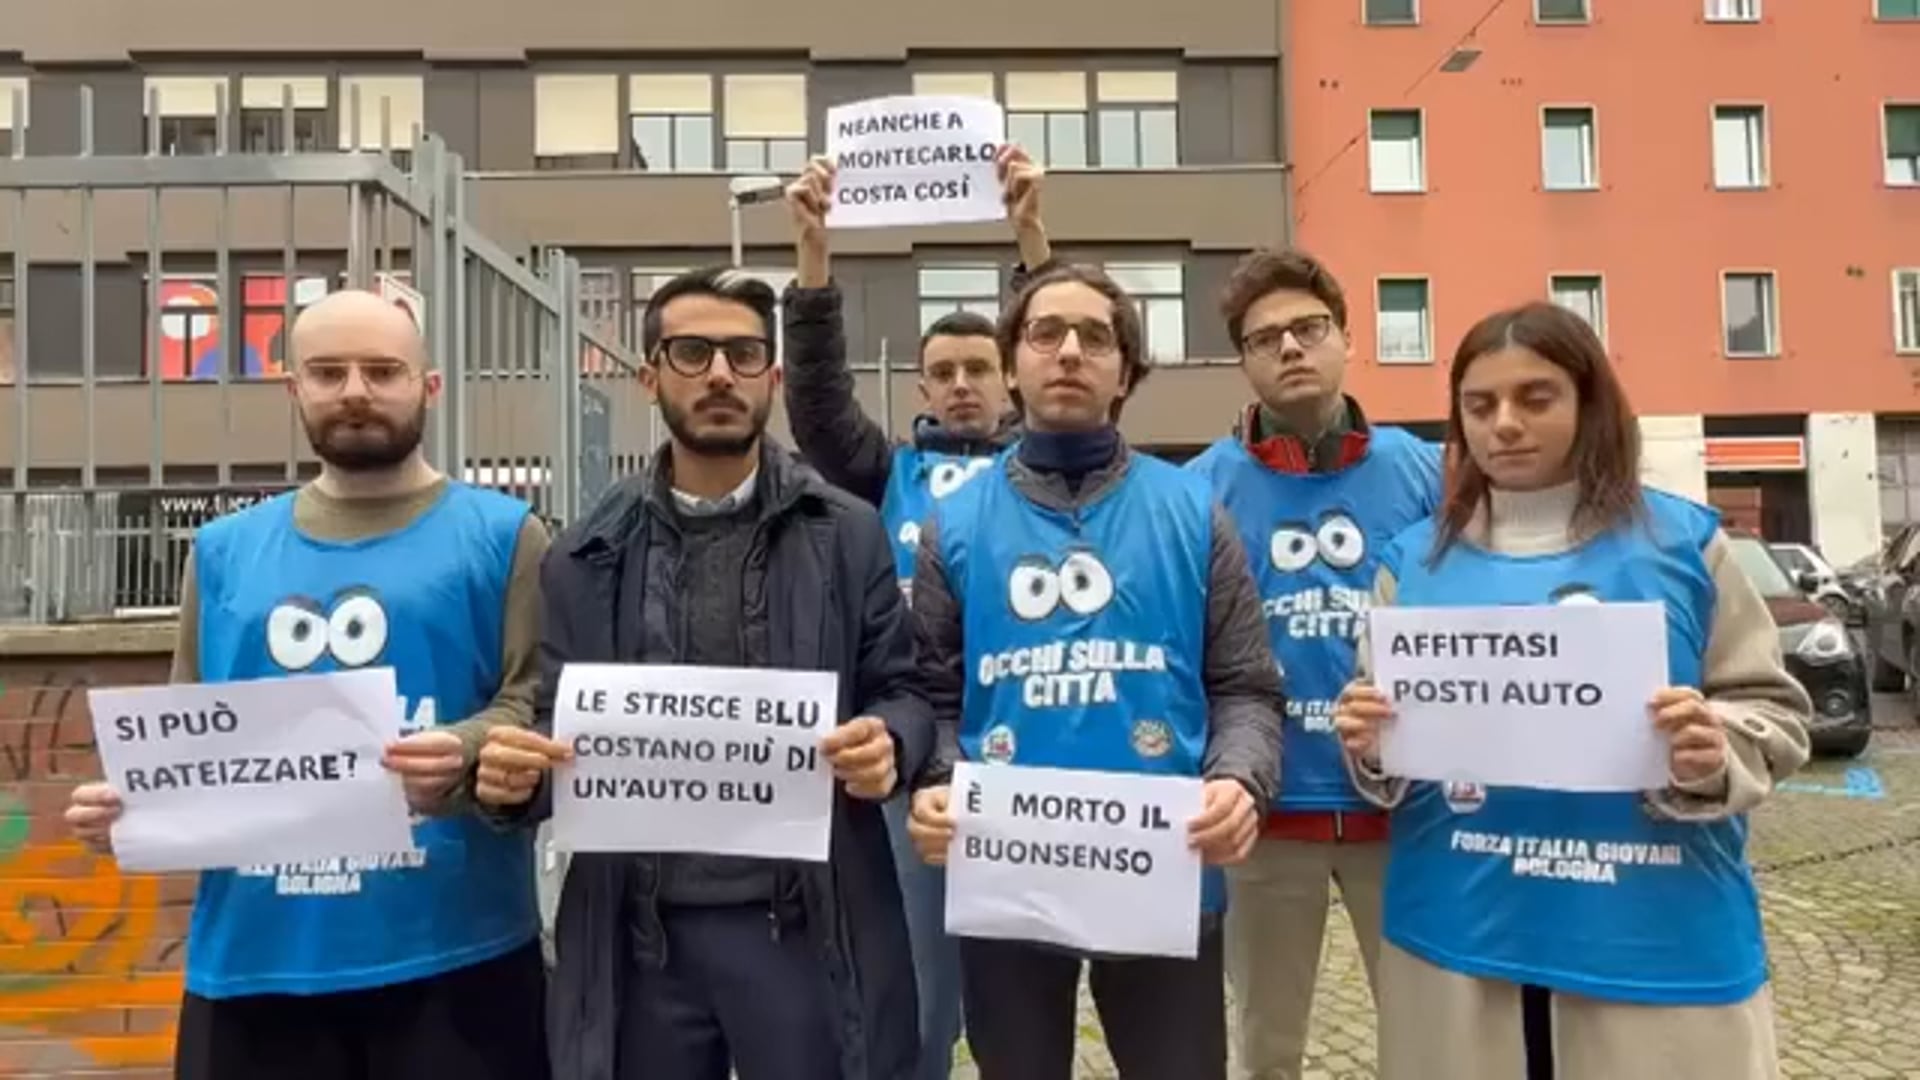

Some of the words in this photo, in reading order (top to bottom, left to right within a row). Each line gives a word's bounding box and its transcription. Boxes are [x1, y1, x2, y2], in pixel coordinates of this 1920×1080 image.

[839, 112, 943, 138] NEANCHE
[947, 112, 964, 130] A
[837, 143, 996, 168] MONTECARLO
[838, 186, 907, 205] COSTA
[914, 174, 970, 200] COSÌ
[978, 641, 1065, 687] OCCHI
[1068, 638, 1167, 672] SULLA
[1390, 632, 1558, 658] AFFITTASI
[575, 689, 607, 713] LE
[622, 690, 742, 720] STRISCE
[755, 698, 820, 729] BLU
[1393, 680, 1489, 704] POSTI
[1502, 682, 1603, 706] AUTO
[115, 714, 147, 741] SI
[159, 701, 239, 738] PUÒ
[573, 734, 715, 762] COSTANO
[724, 737, 775, 765] PIÙ
[786, 746, 817, 771] DI
[125, 751, 358, 792] RATEIZZARE?
[573, 777, 708, 801] UN'AUTO
[718, 780, 775, 805] BLU
[967, 782, 982, 813] È
[1011, 793, 1126, 825] MORTO
[1140, 804, 1171, 830] IL
[965, 834, 1153, 876] BUONSENSO
[1451, 830, 1512, 856] FORZA
[1516, 836, 1589, 859] ITALIA
[1595, 841, 1682, 865] GIOVANI
[1512, 856, 1617, 885] BOLOGNA
